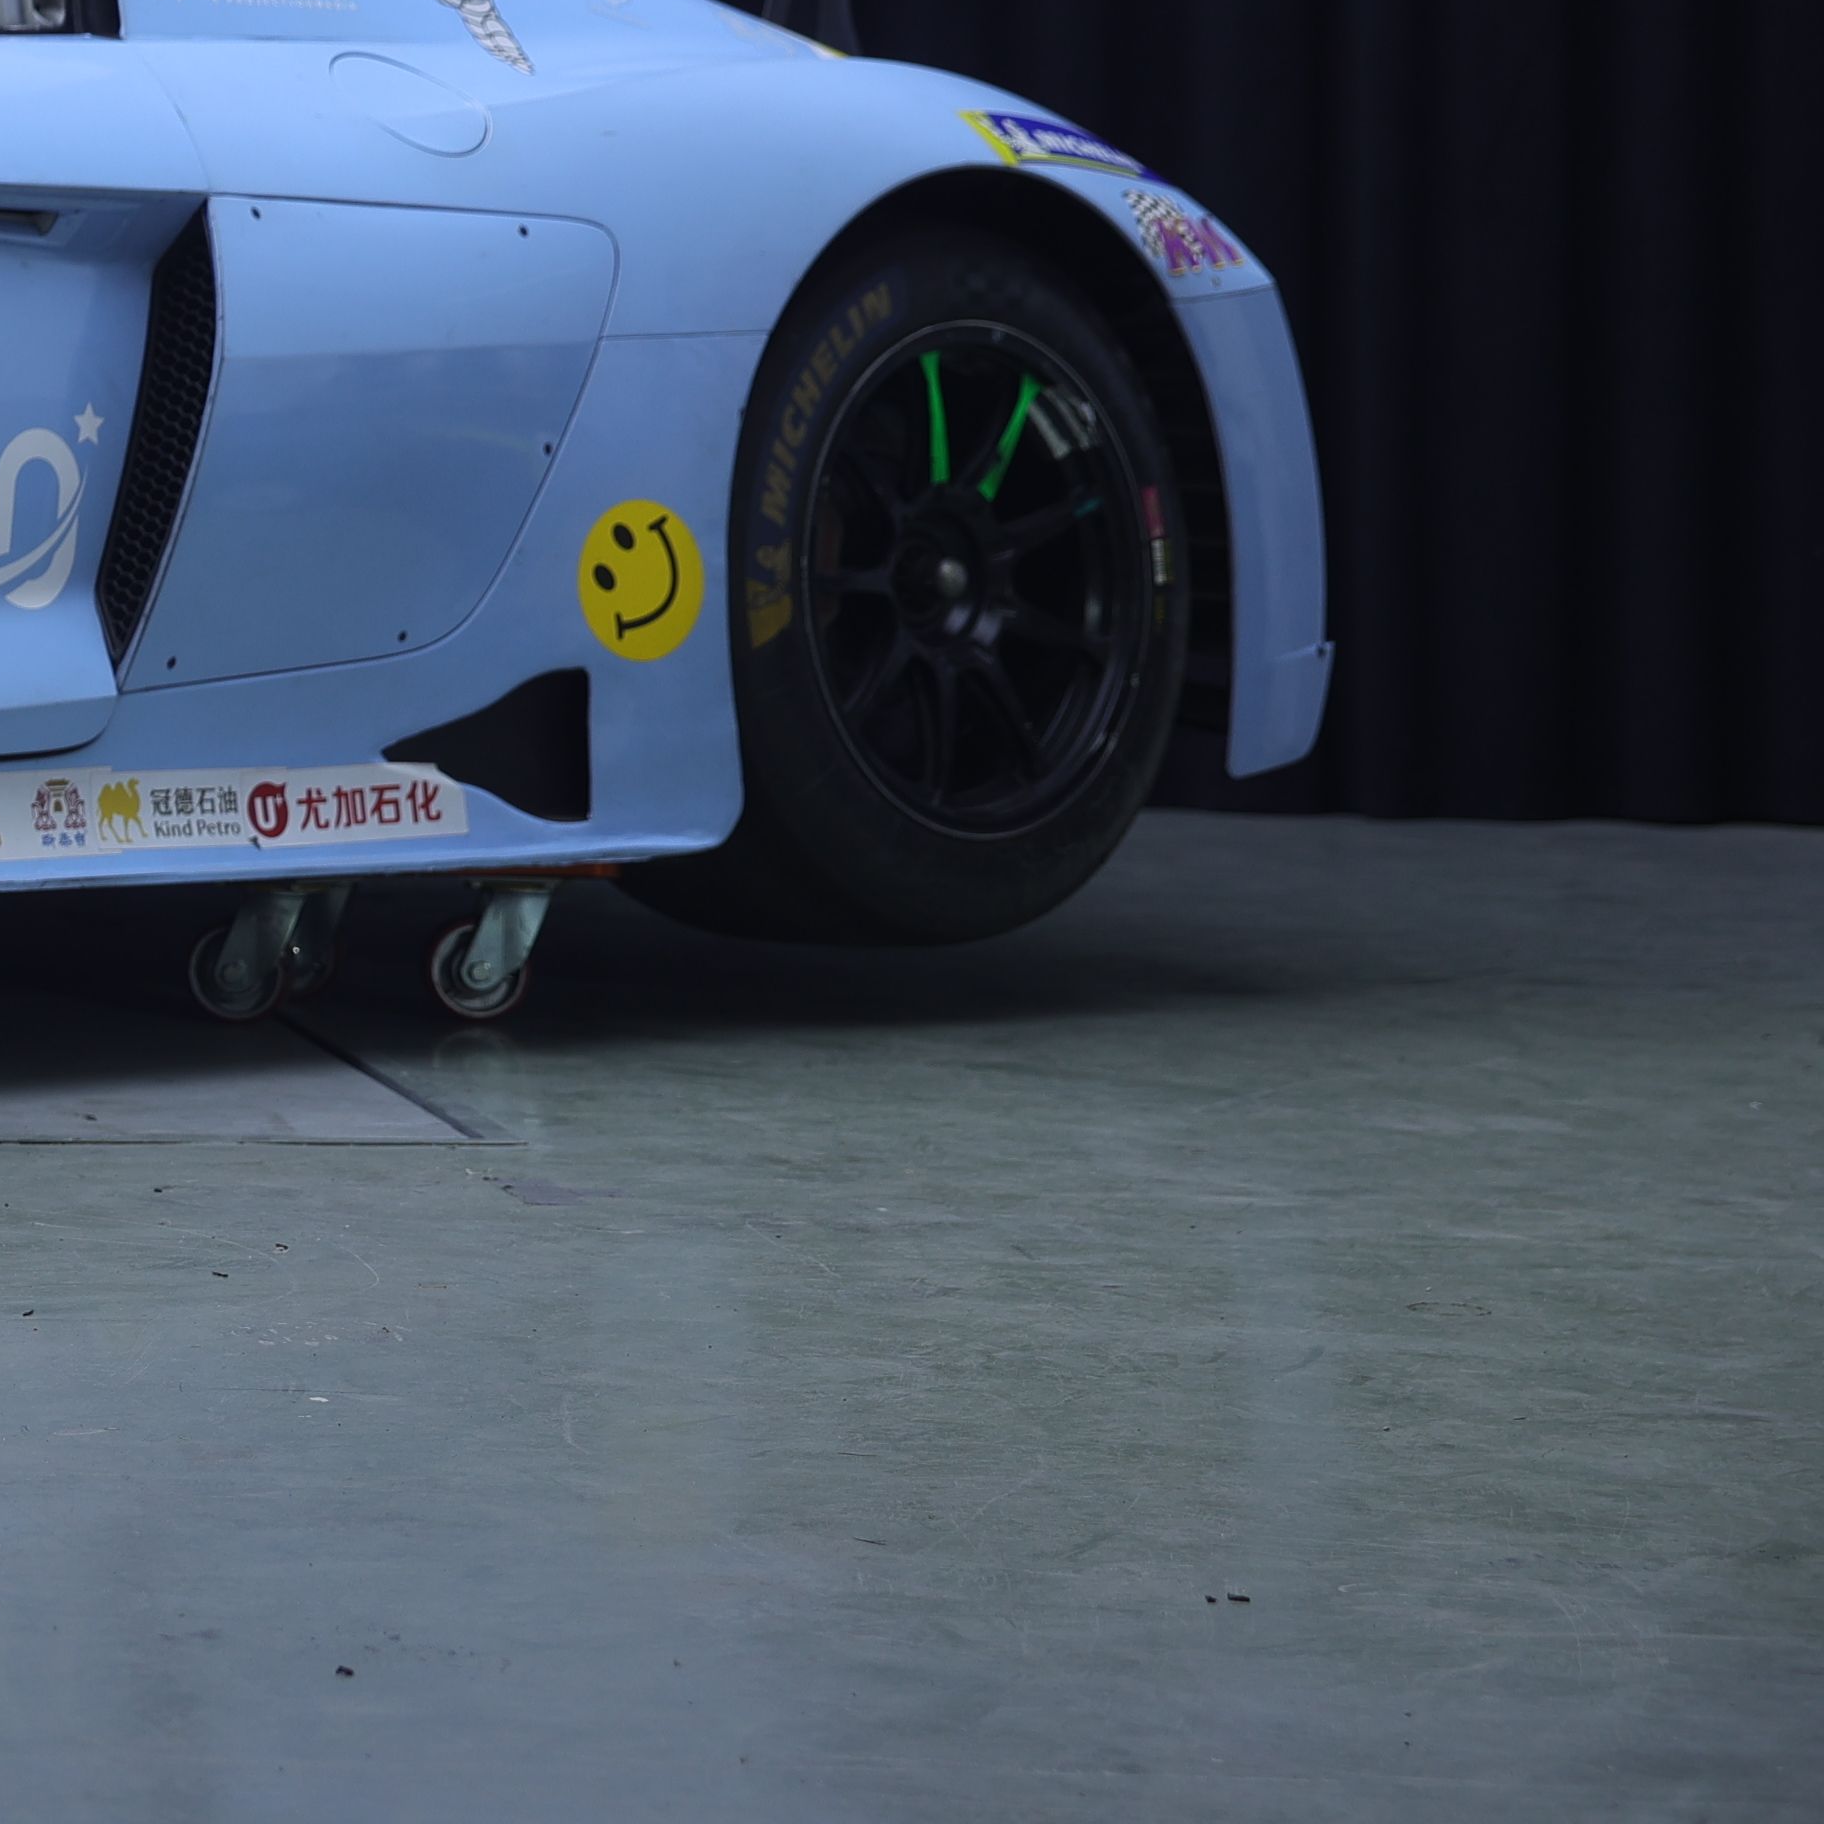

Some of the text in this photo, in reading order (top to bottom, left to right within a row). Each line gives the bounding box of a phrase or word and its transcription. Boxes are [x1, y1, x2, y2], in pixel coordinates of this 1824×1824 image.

[760, 280, 893, 528] MICHELIN
[150, 784, 240, 817] 冠德石油
[296, 780, 443, 832] 尤加石化
[155, 818, 242, 838] Kind Petro
